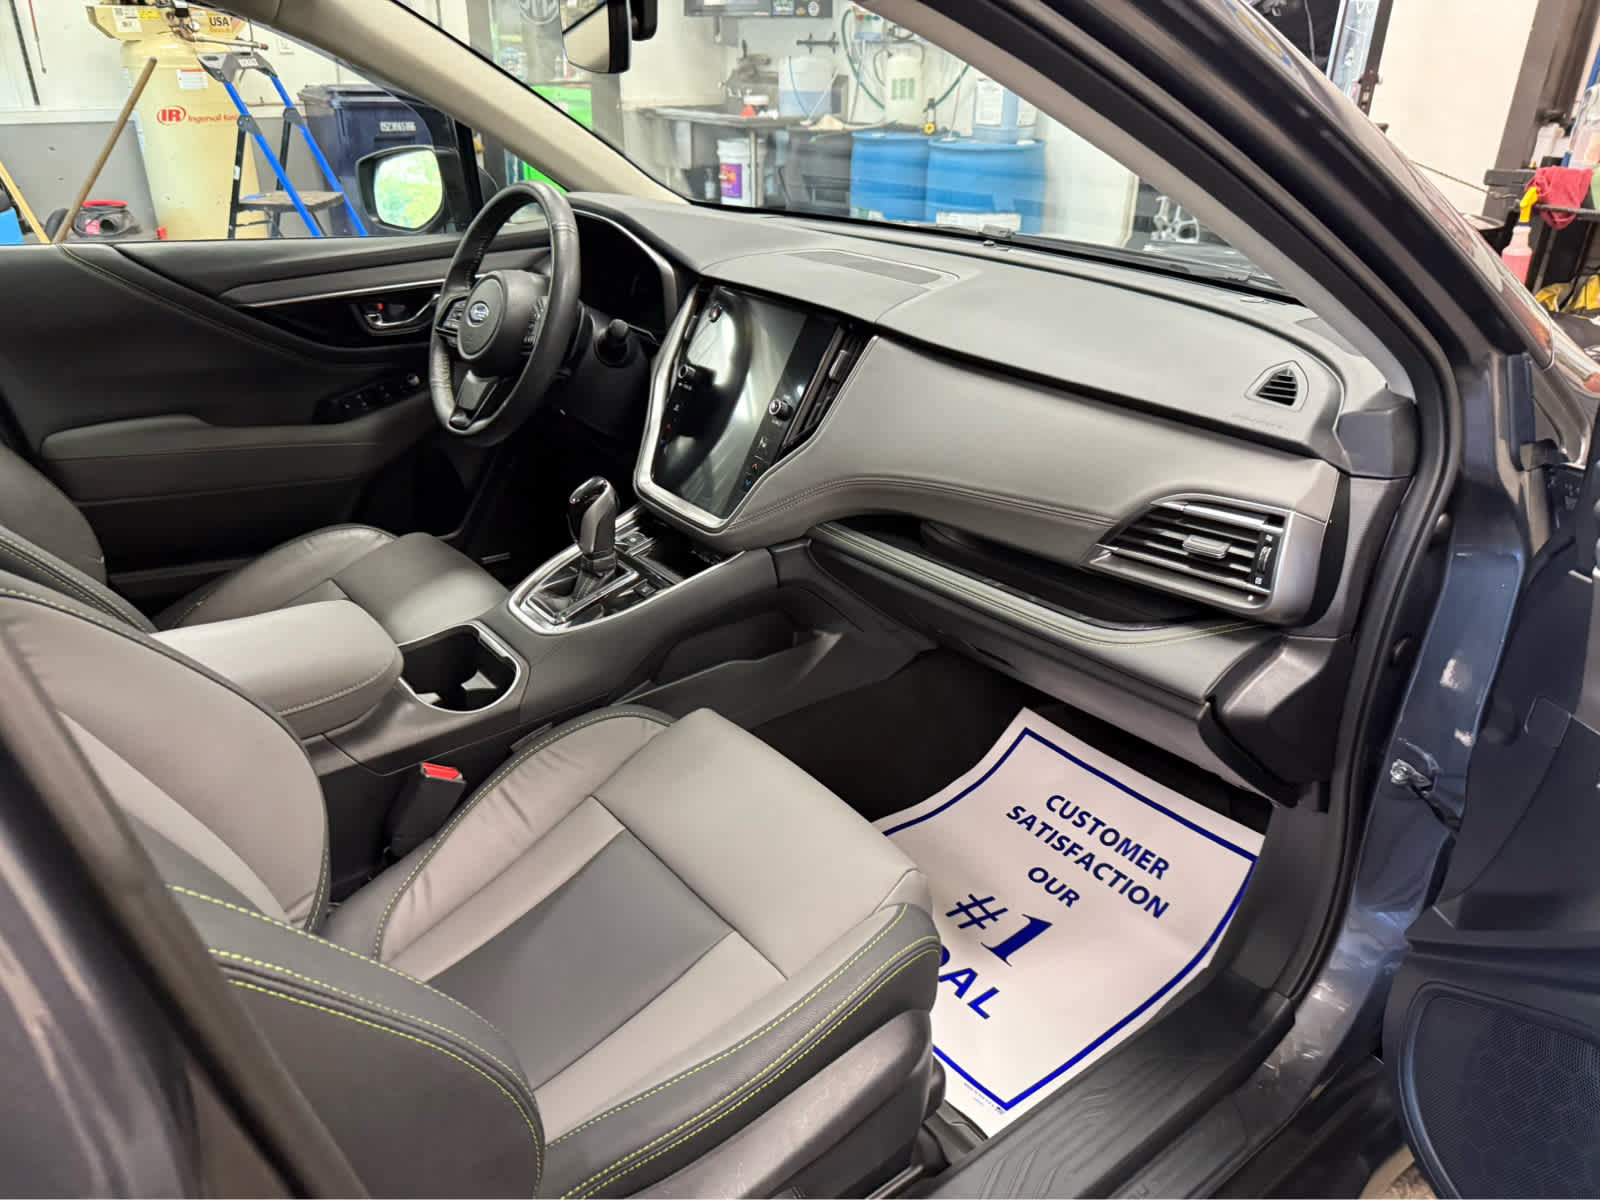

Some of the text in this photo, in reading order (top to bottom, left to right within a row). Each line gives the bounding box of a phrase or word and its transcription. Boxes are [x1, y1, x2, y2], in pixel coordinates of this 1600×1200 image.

[209, 16, 230, 27] USA
[1006, 804, 1170, 919] SATISFACTION
[1046, 794, 1170, 880] CUSTOMER
[1028, 866, 1081, 908] OUR
[945, 893, 1053, 968] #1
[938, 946, 999, 1019] AL
